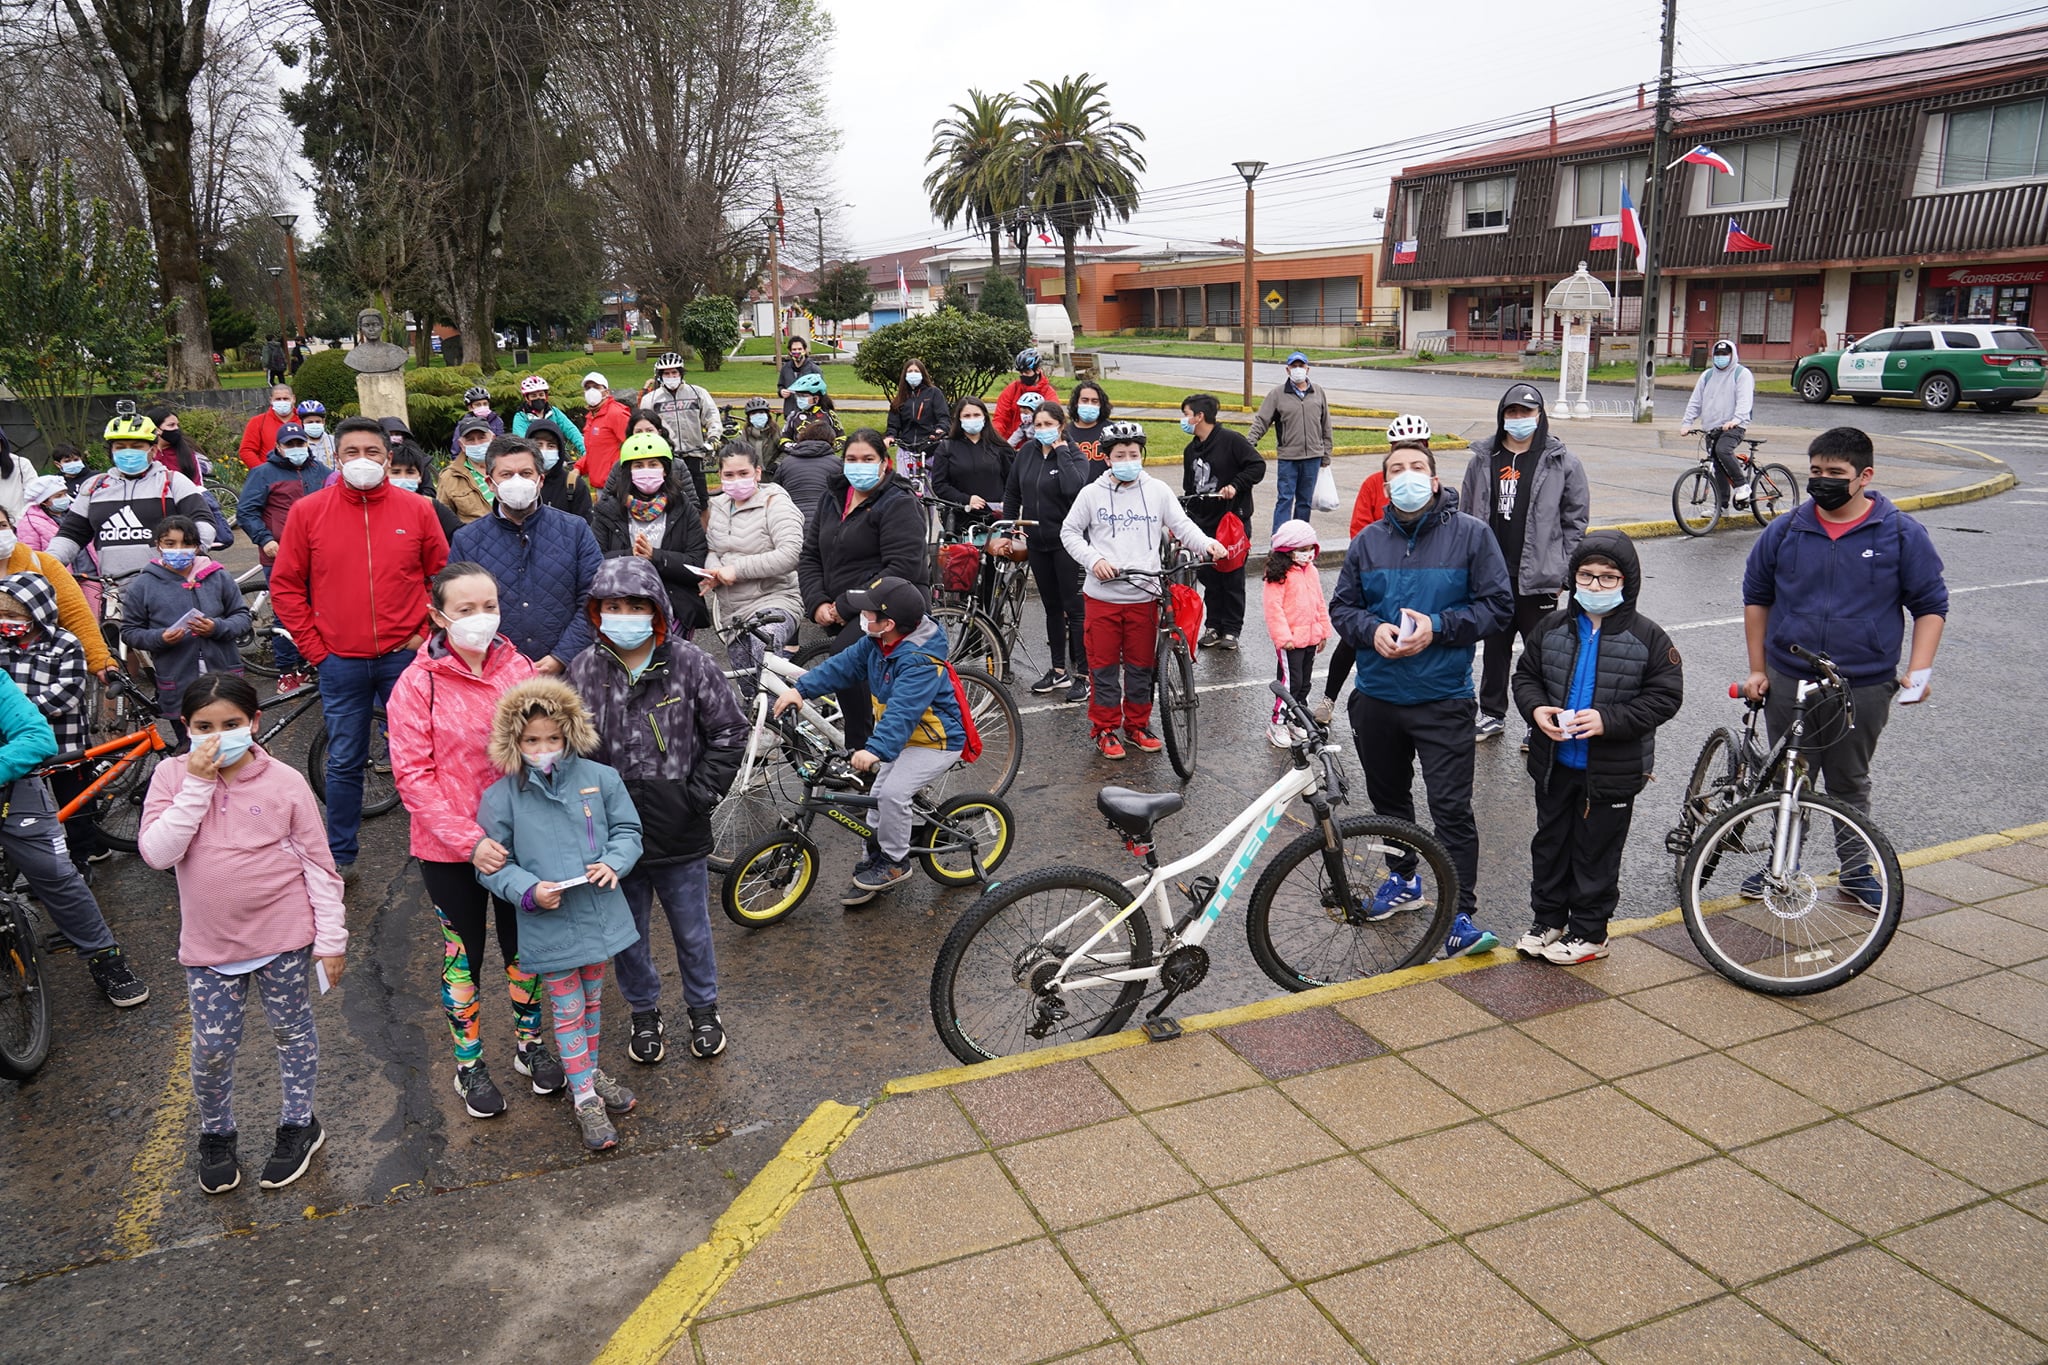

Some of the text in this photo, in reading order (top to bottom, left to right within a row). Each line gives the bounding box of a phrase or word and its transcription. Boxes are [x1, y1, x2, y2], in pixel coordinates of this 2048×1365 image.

[1074, 440, 1106, 461] SC
[99, 527, 153, 541] adidas
[828, 809, 872, 837] OXFORD
[1201, 805, 1284, 924] TREK
